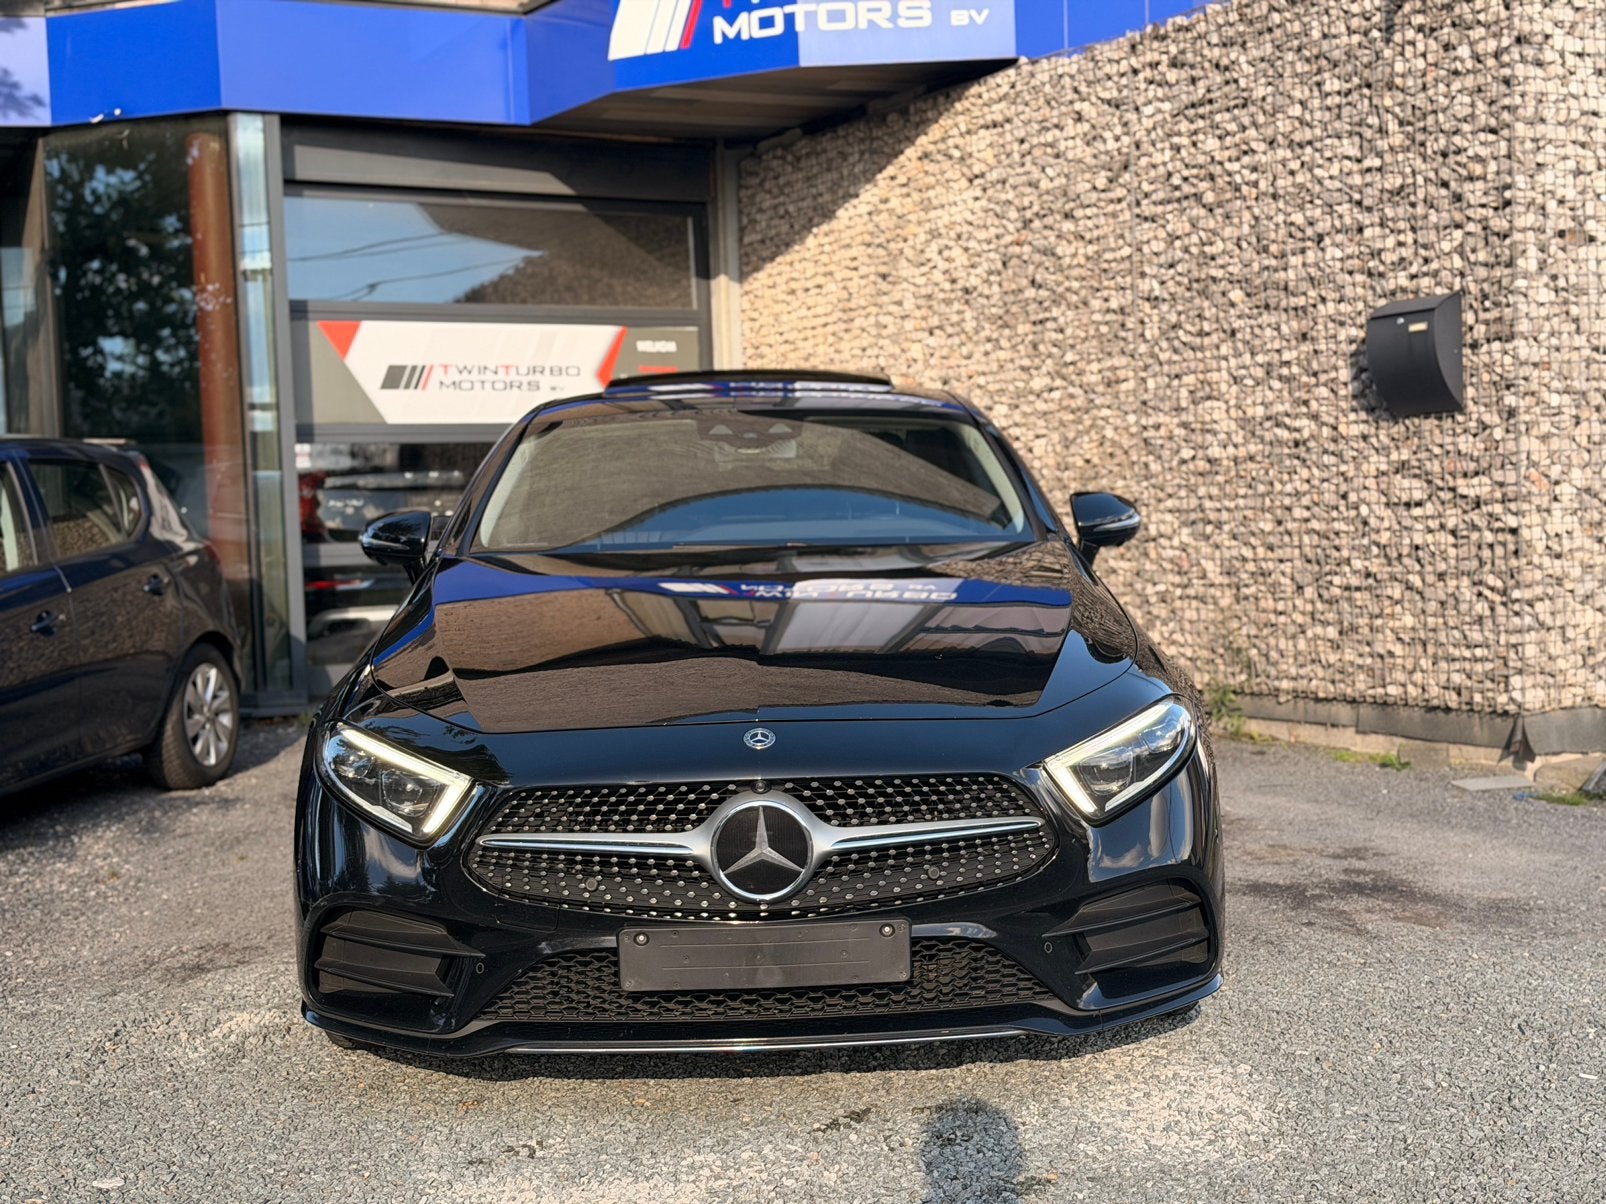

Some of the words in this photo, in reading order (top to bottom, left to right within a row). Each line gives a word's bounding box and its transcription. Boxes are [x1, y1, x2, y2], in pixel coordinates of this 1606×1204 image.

[713, 0, 933, 45] MOTORS
[950, 8, 990, 26] BV
[438, 364, 581, 377] TWINTURBO
[438, 379, 541, 392] MOTORS
